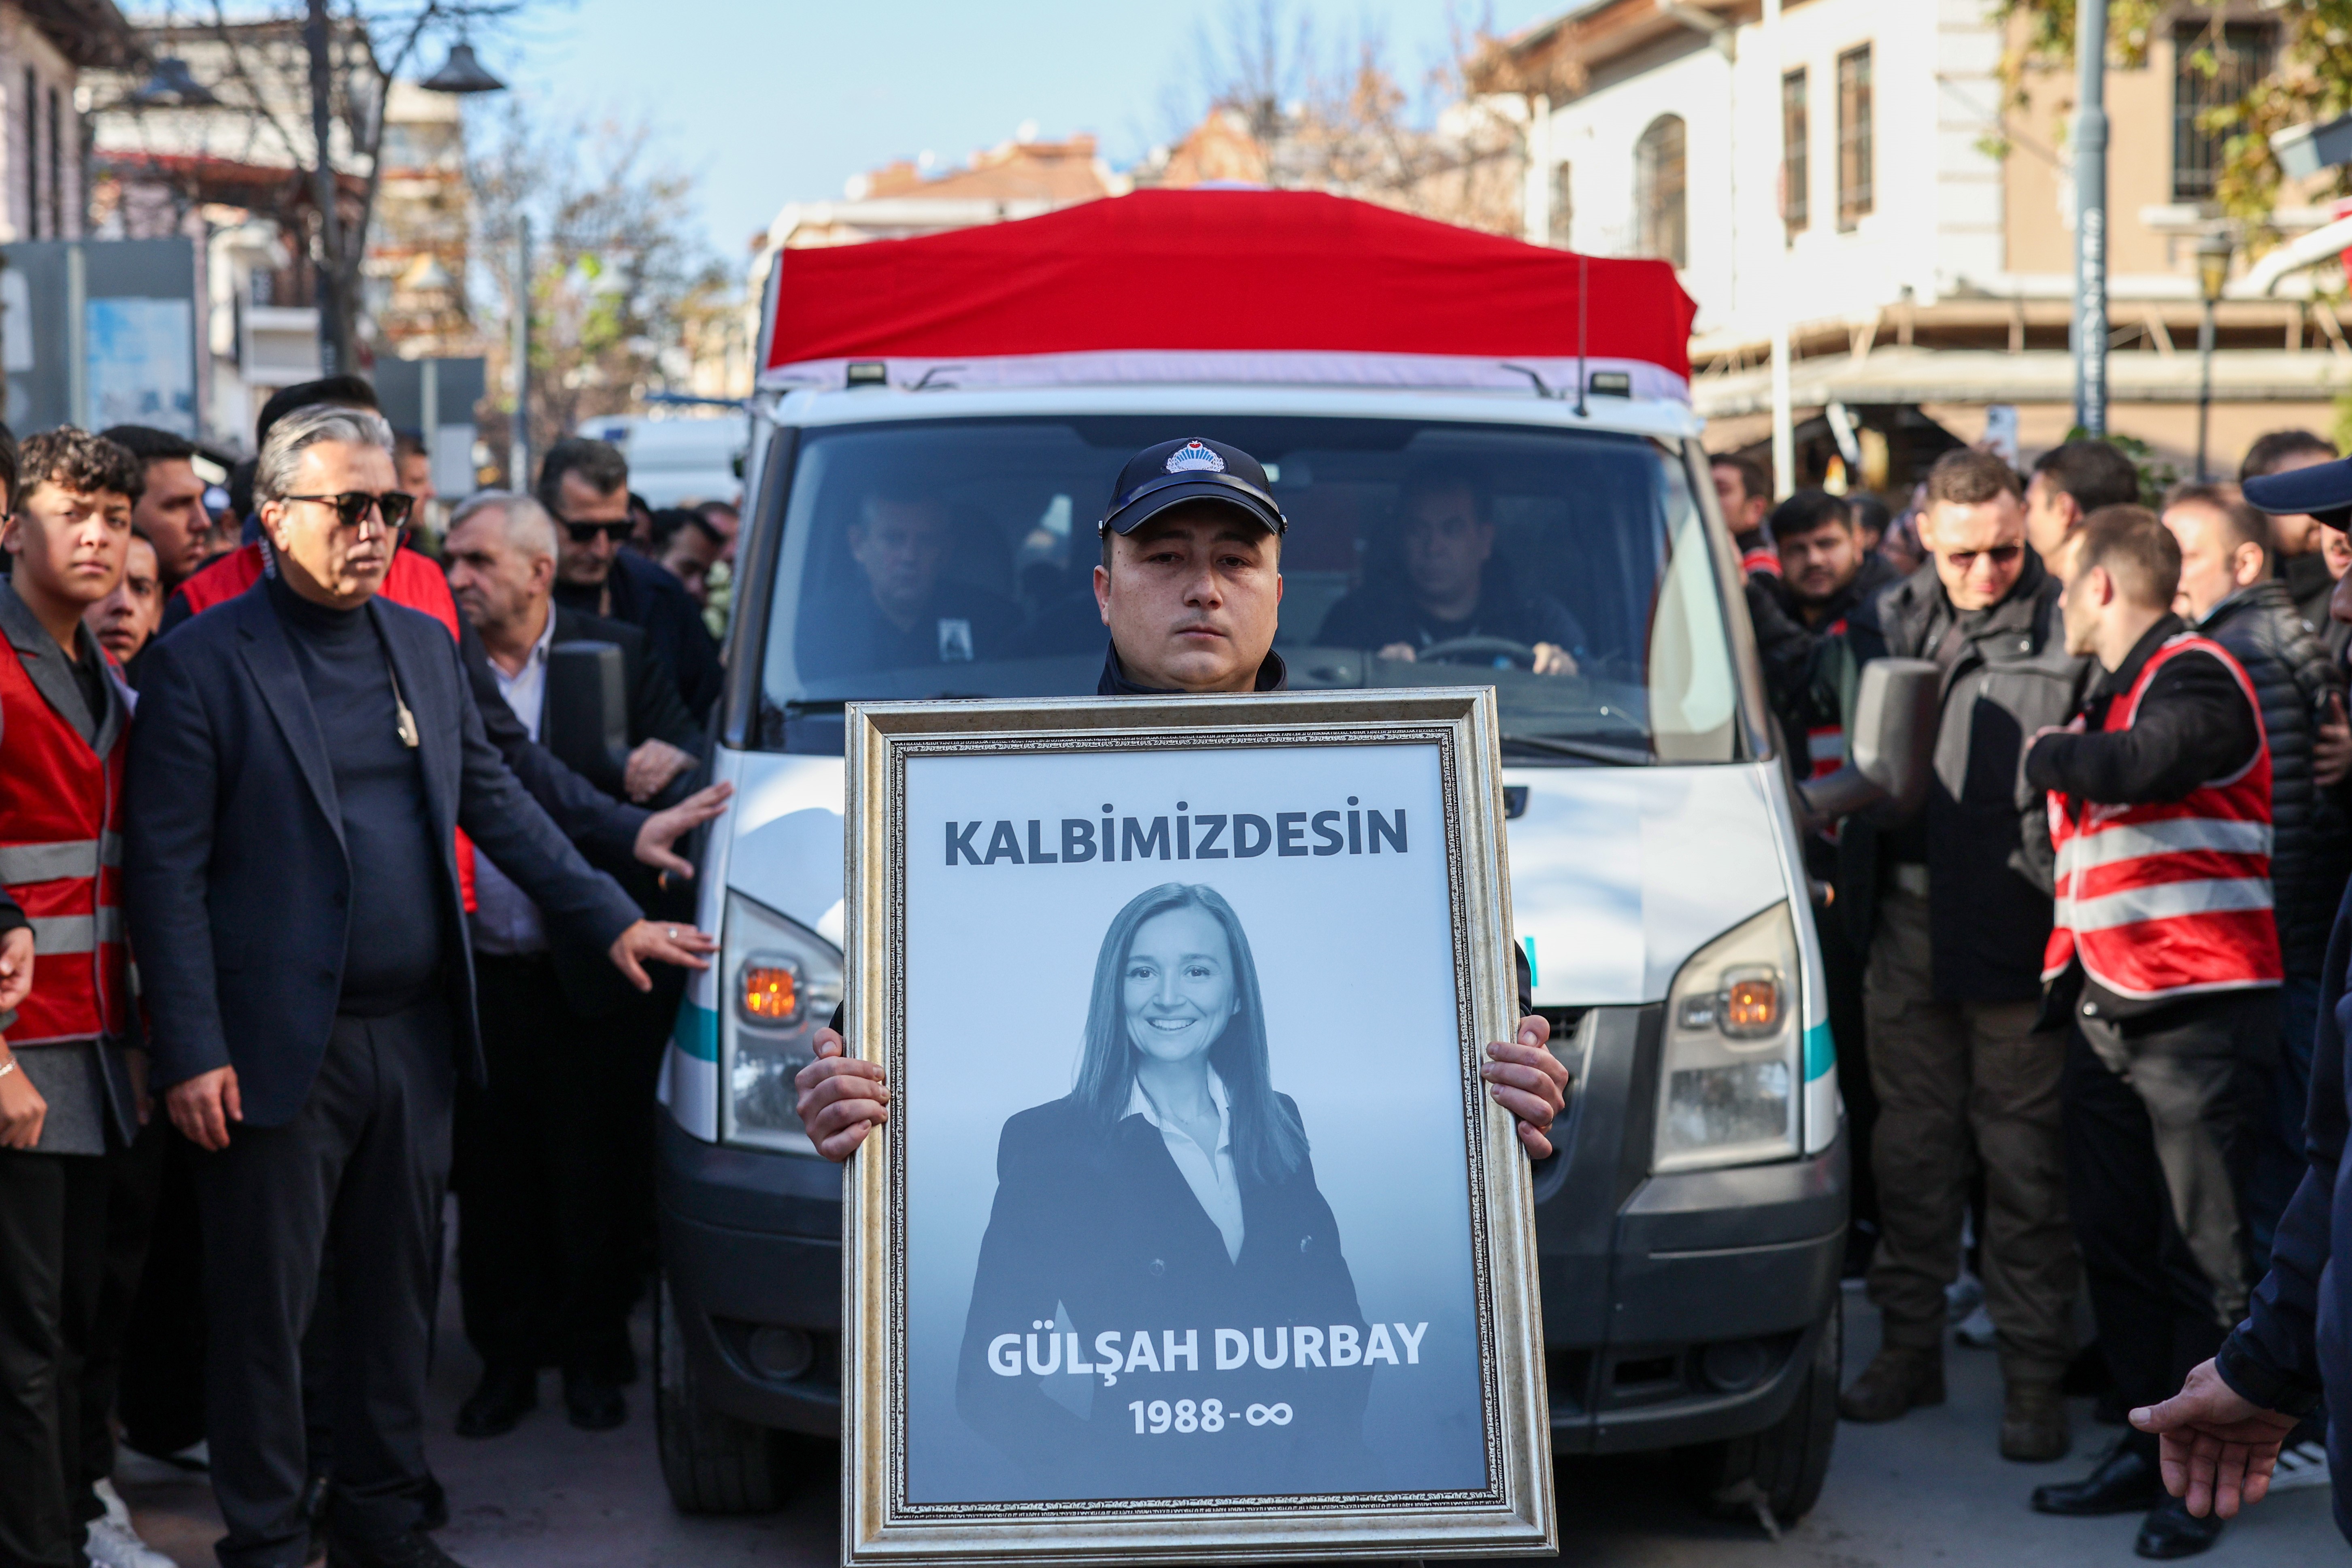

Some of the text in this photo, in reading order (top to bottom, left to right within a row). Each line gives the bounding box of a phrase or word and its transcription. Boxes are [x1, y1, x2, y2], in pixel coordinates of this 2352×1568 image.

[946, 796, 1408, 866] KALBİMİZDESİN
[988, 1319, 1429, 1387] GÜLŞAH DURBAY
